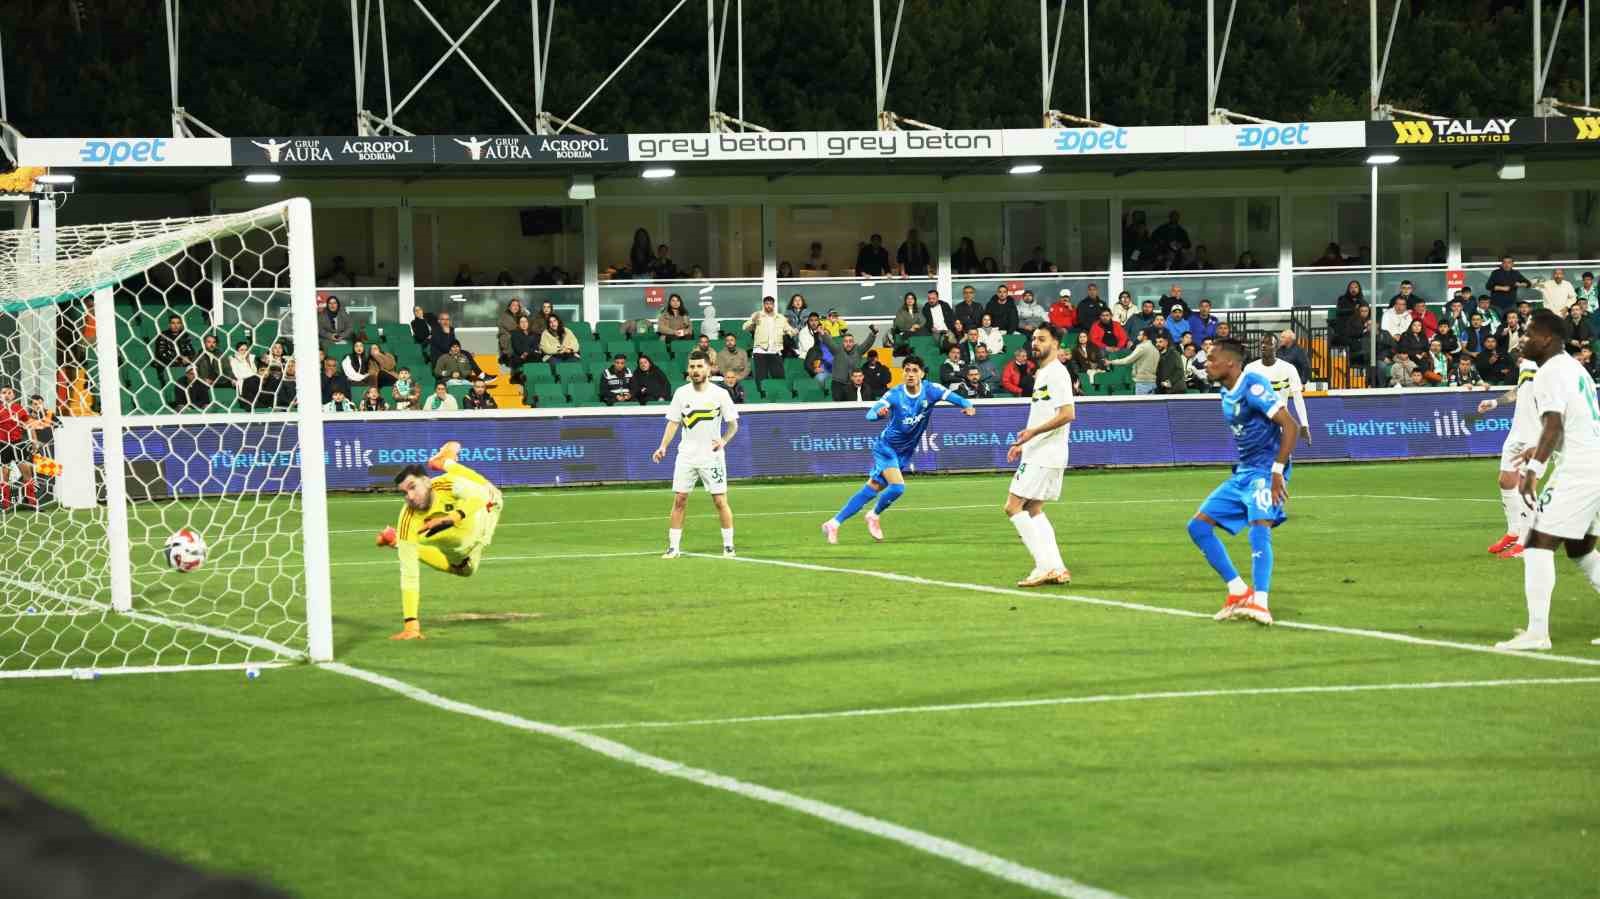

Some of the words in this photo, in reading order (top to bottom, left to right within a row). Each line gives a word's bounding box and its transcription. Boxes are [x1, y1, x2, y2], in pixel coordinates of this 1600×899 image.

[1432, 119, 1517, 135] TALAY
[495, 138, 519, 146] GRUP
[1054, 127, 1128, 153] opet
[1235, 123, 1310, 149] opet
[1438, 135, 1511, 143] LOGISTICS
[294, 140, 320, 148] GRUP
[341, 140, 413, 154] ACROPOL
[540, 138, 609, 151] ACROPOL
[638, 135, 709, 158] grey
[719, 134, 806, 152] beton
[827, 133, 897, 156] grey
[906, 131, 991, 150] beton
[80, 139, 165, 165] opet
[285, 147, 333, 161] AURA
[358, 153, 396, 161] BODRUM
[485, 146, 532, 159] AURA
[556, 151, 593, 159] BODRUM
[1475, 418, 1511, 432] BOR
[943, 432, 1000, 446] BORSA
[459, 447, 502, 462] RACI
[506, 444, 585, 461] KURUMU
